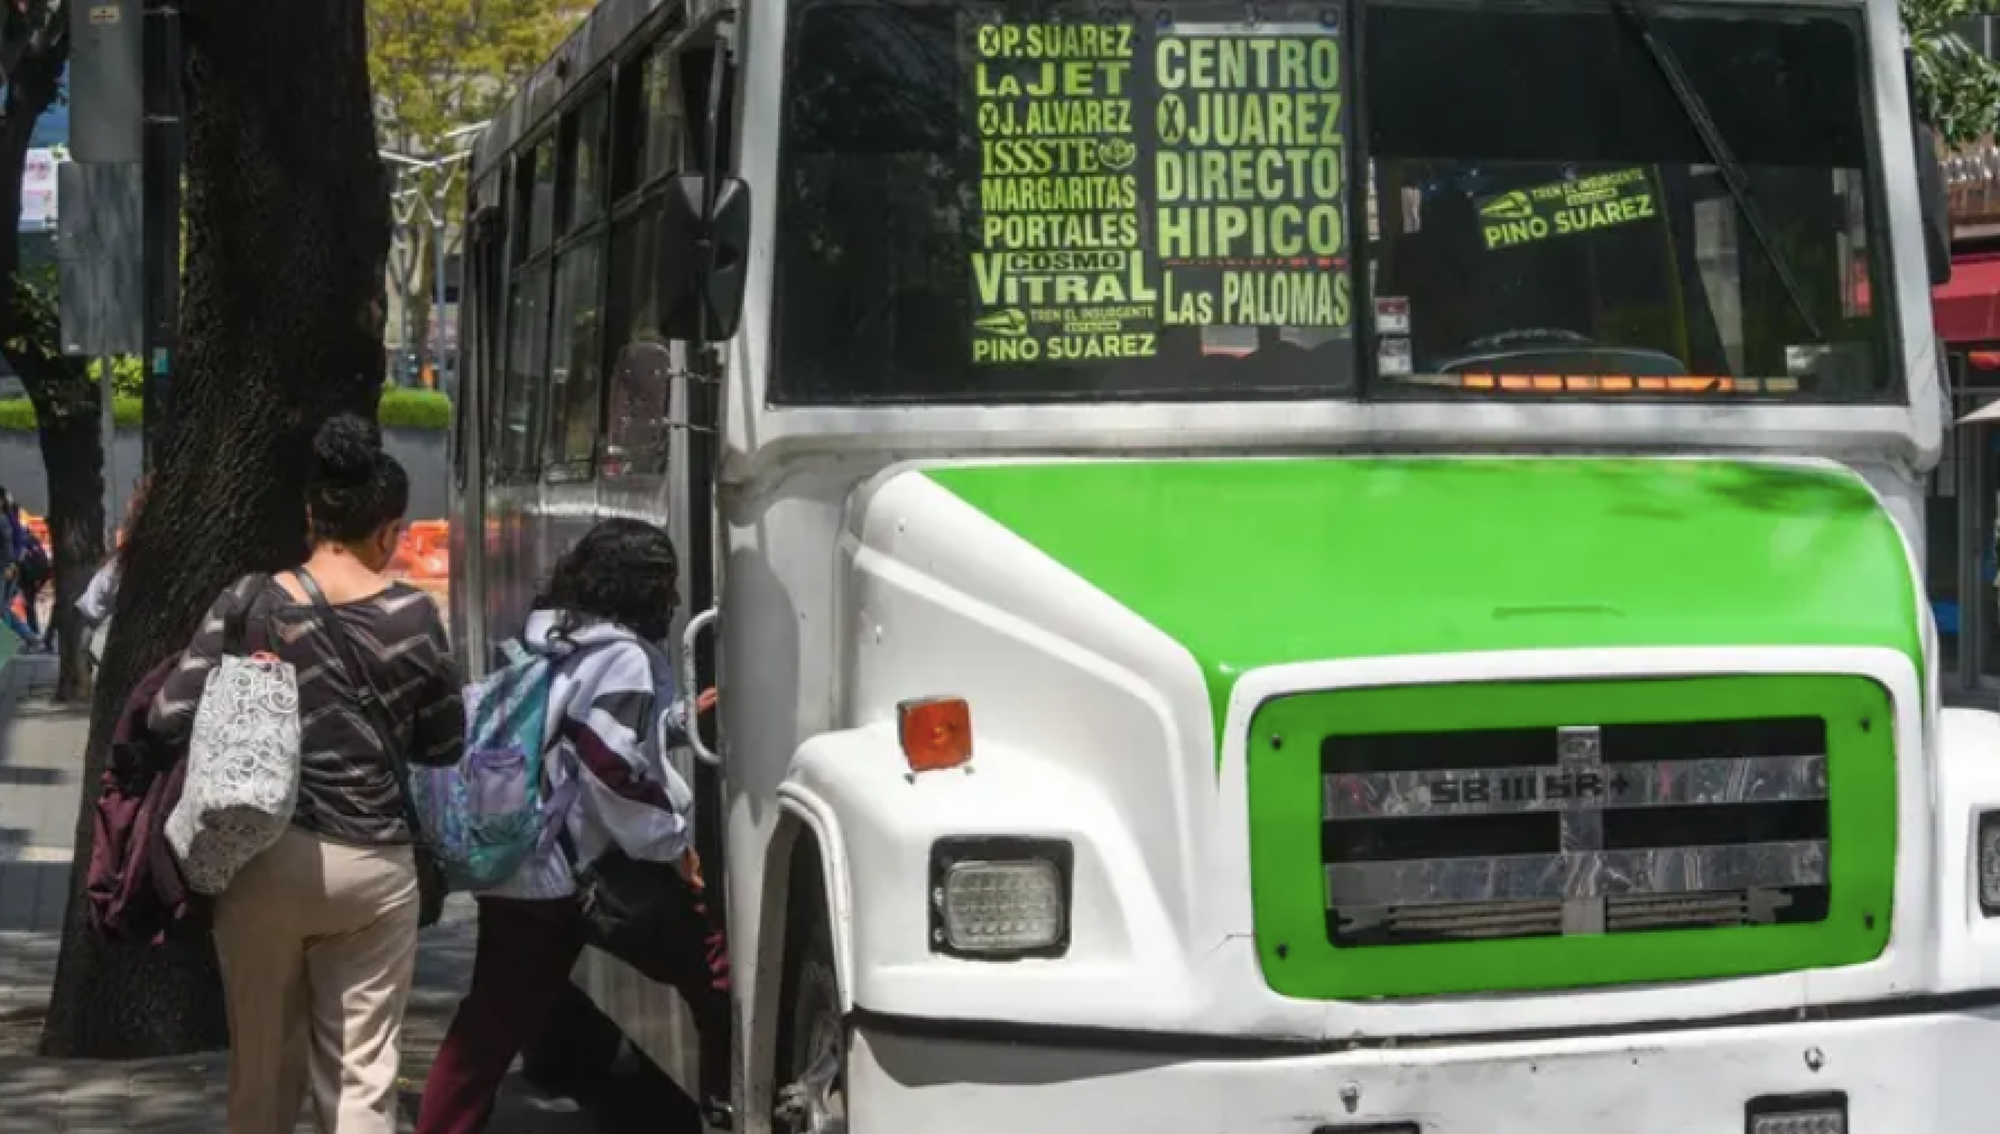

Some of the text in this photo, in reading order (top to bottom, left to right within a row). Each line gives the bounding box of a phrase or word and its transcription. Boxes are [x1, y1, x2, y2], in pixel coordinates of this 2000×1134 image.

[1026, 61, 1131, 95] JET
[1156, 38, 1339, 90] CENTRO
[1188, 92, 1342, 146] JUAREZ
[982, 138, 1099, 174] ISSSTE
[1157, 148, 1340, 201] DIRECTO
[981, 174, 1136, 211] MARGARITAS
[984, 213, 1137, 248] PORTALES
[1158, 203, 1342, 257] HIPICO
[1485, 216, 1547, 249] PINO
[971, 250, 1158, 305] VITRAL
[1009, 252, 1122, 270] COSMO
[1222, 270, 1350, 326] PALOMAS
[973, 337, 1040, 363] PINO
